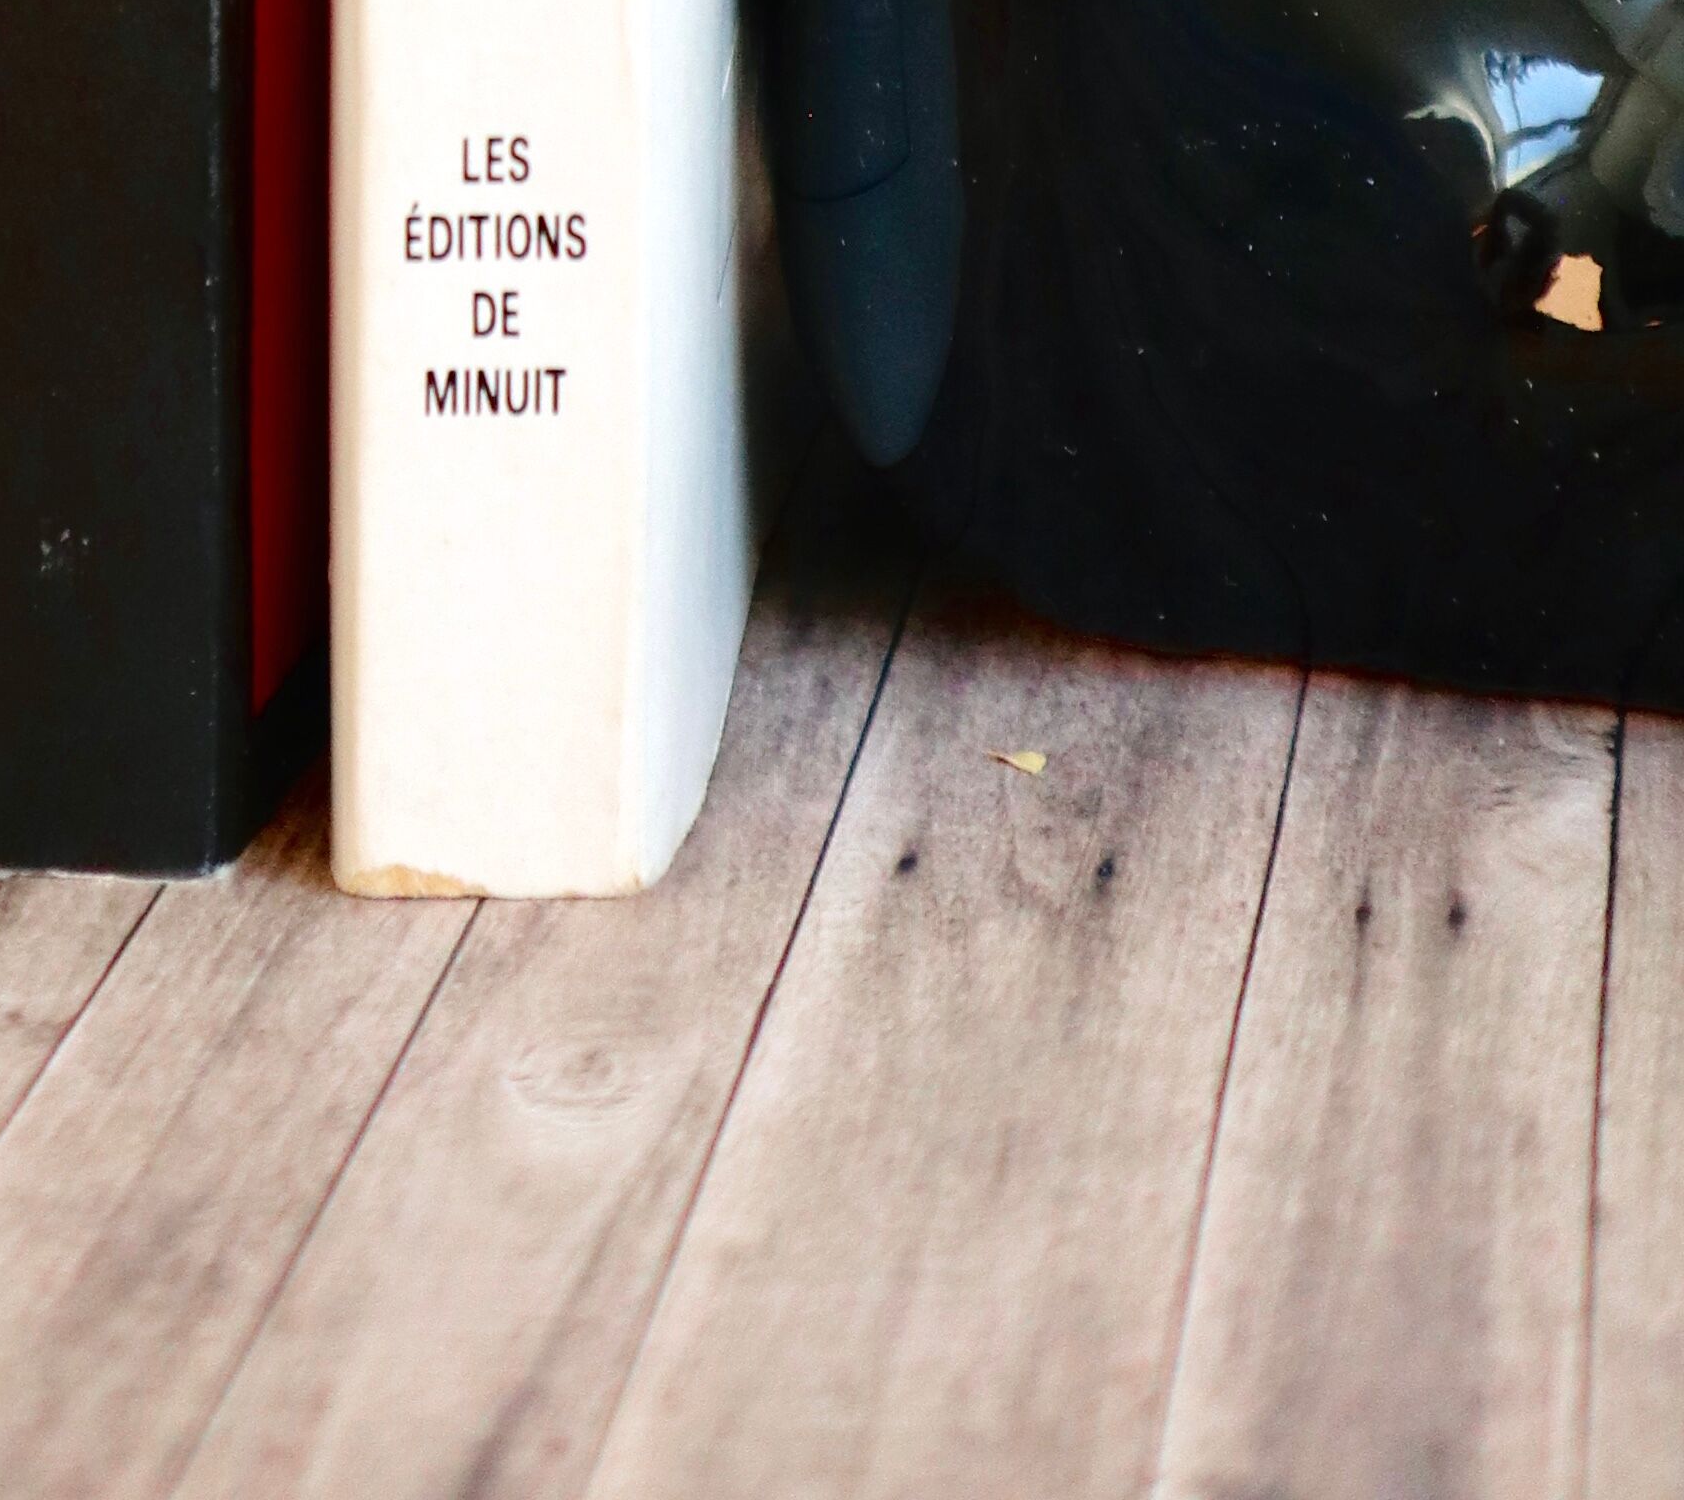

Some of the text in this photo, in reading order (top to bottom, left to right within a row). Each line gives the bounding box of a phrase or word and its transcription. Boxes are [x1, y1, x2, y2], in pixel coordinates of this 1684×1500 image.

[461, 135, 531, 184] LES
[403, 202, 587, 262] ÉDITIONS
[471, 289, 520, 338] DE
[424, 366, 567, 416] MINUIT
